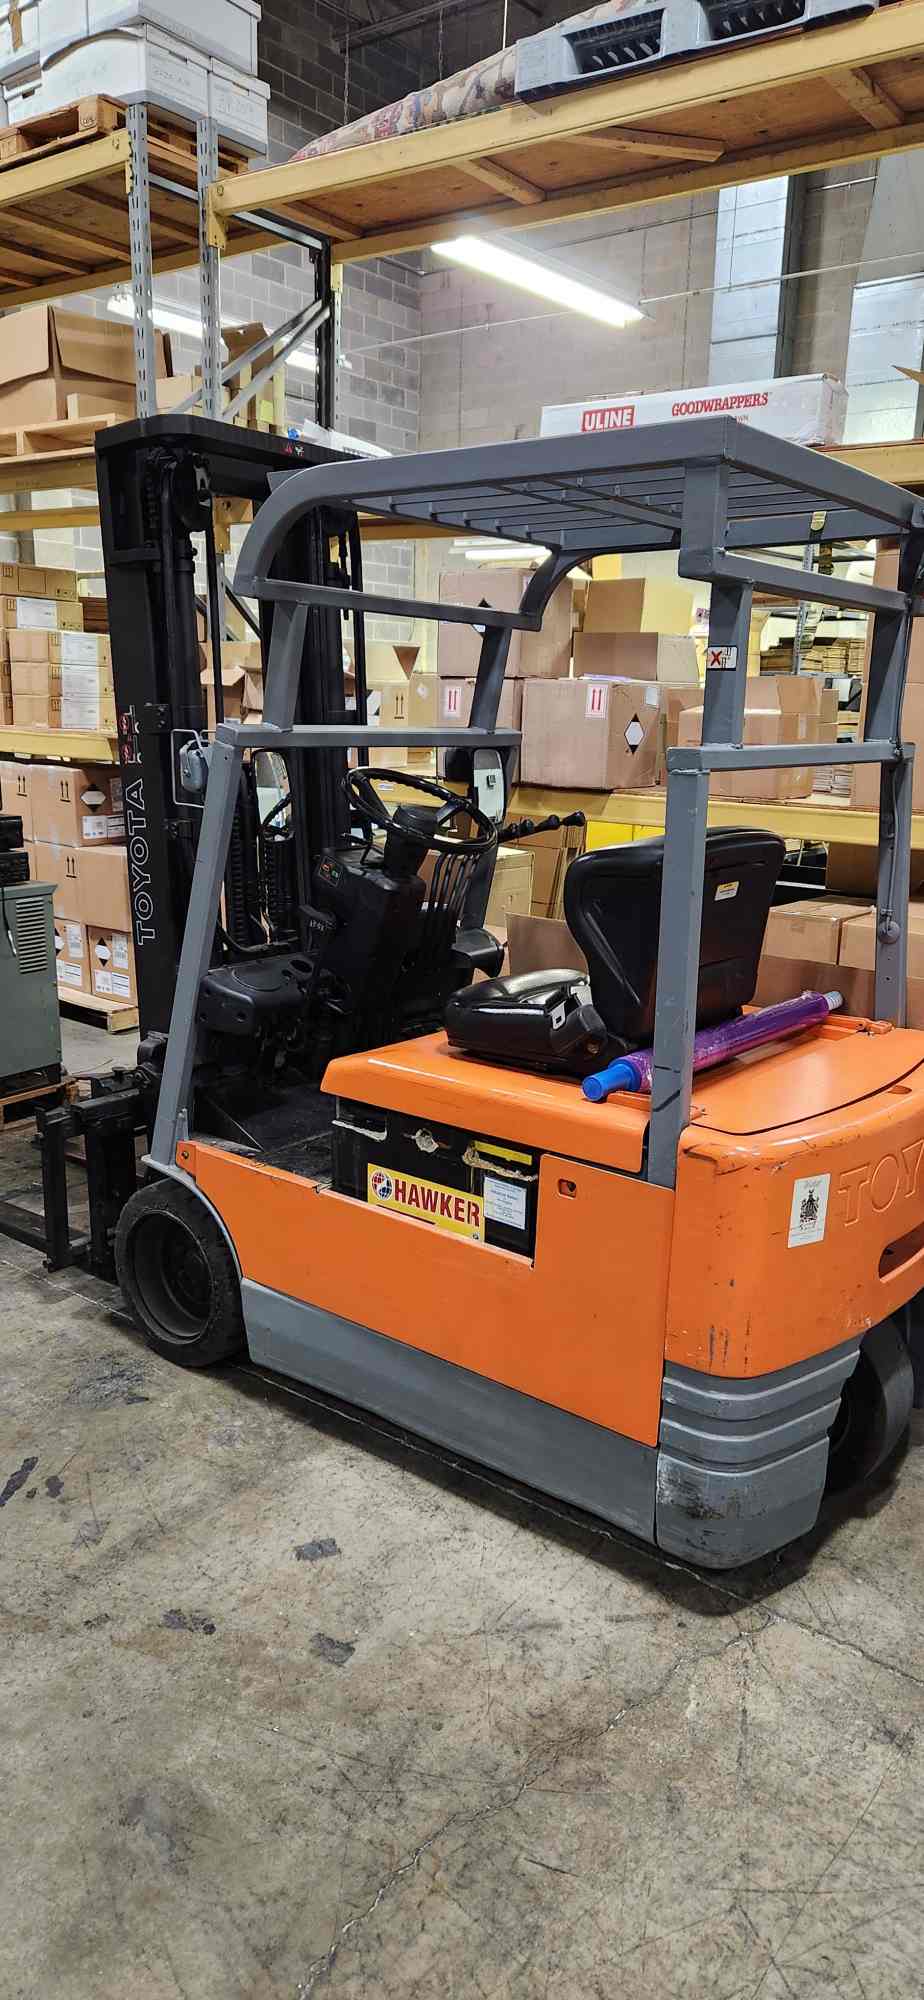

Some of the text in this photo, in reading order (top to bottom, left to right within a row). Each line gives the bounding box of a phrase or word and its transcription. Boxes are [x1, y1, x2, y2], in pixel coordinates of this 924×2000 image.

[583, 408, 633, 431] ULINE
[672, 391, 769, 417] GOODWRAPPERS
[125, 778, 156, 946] TOYOTA
[394, 1179, 480, 1227] HAWKER
